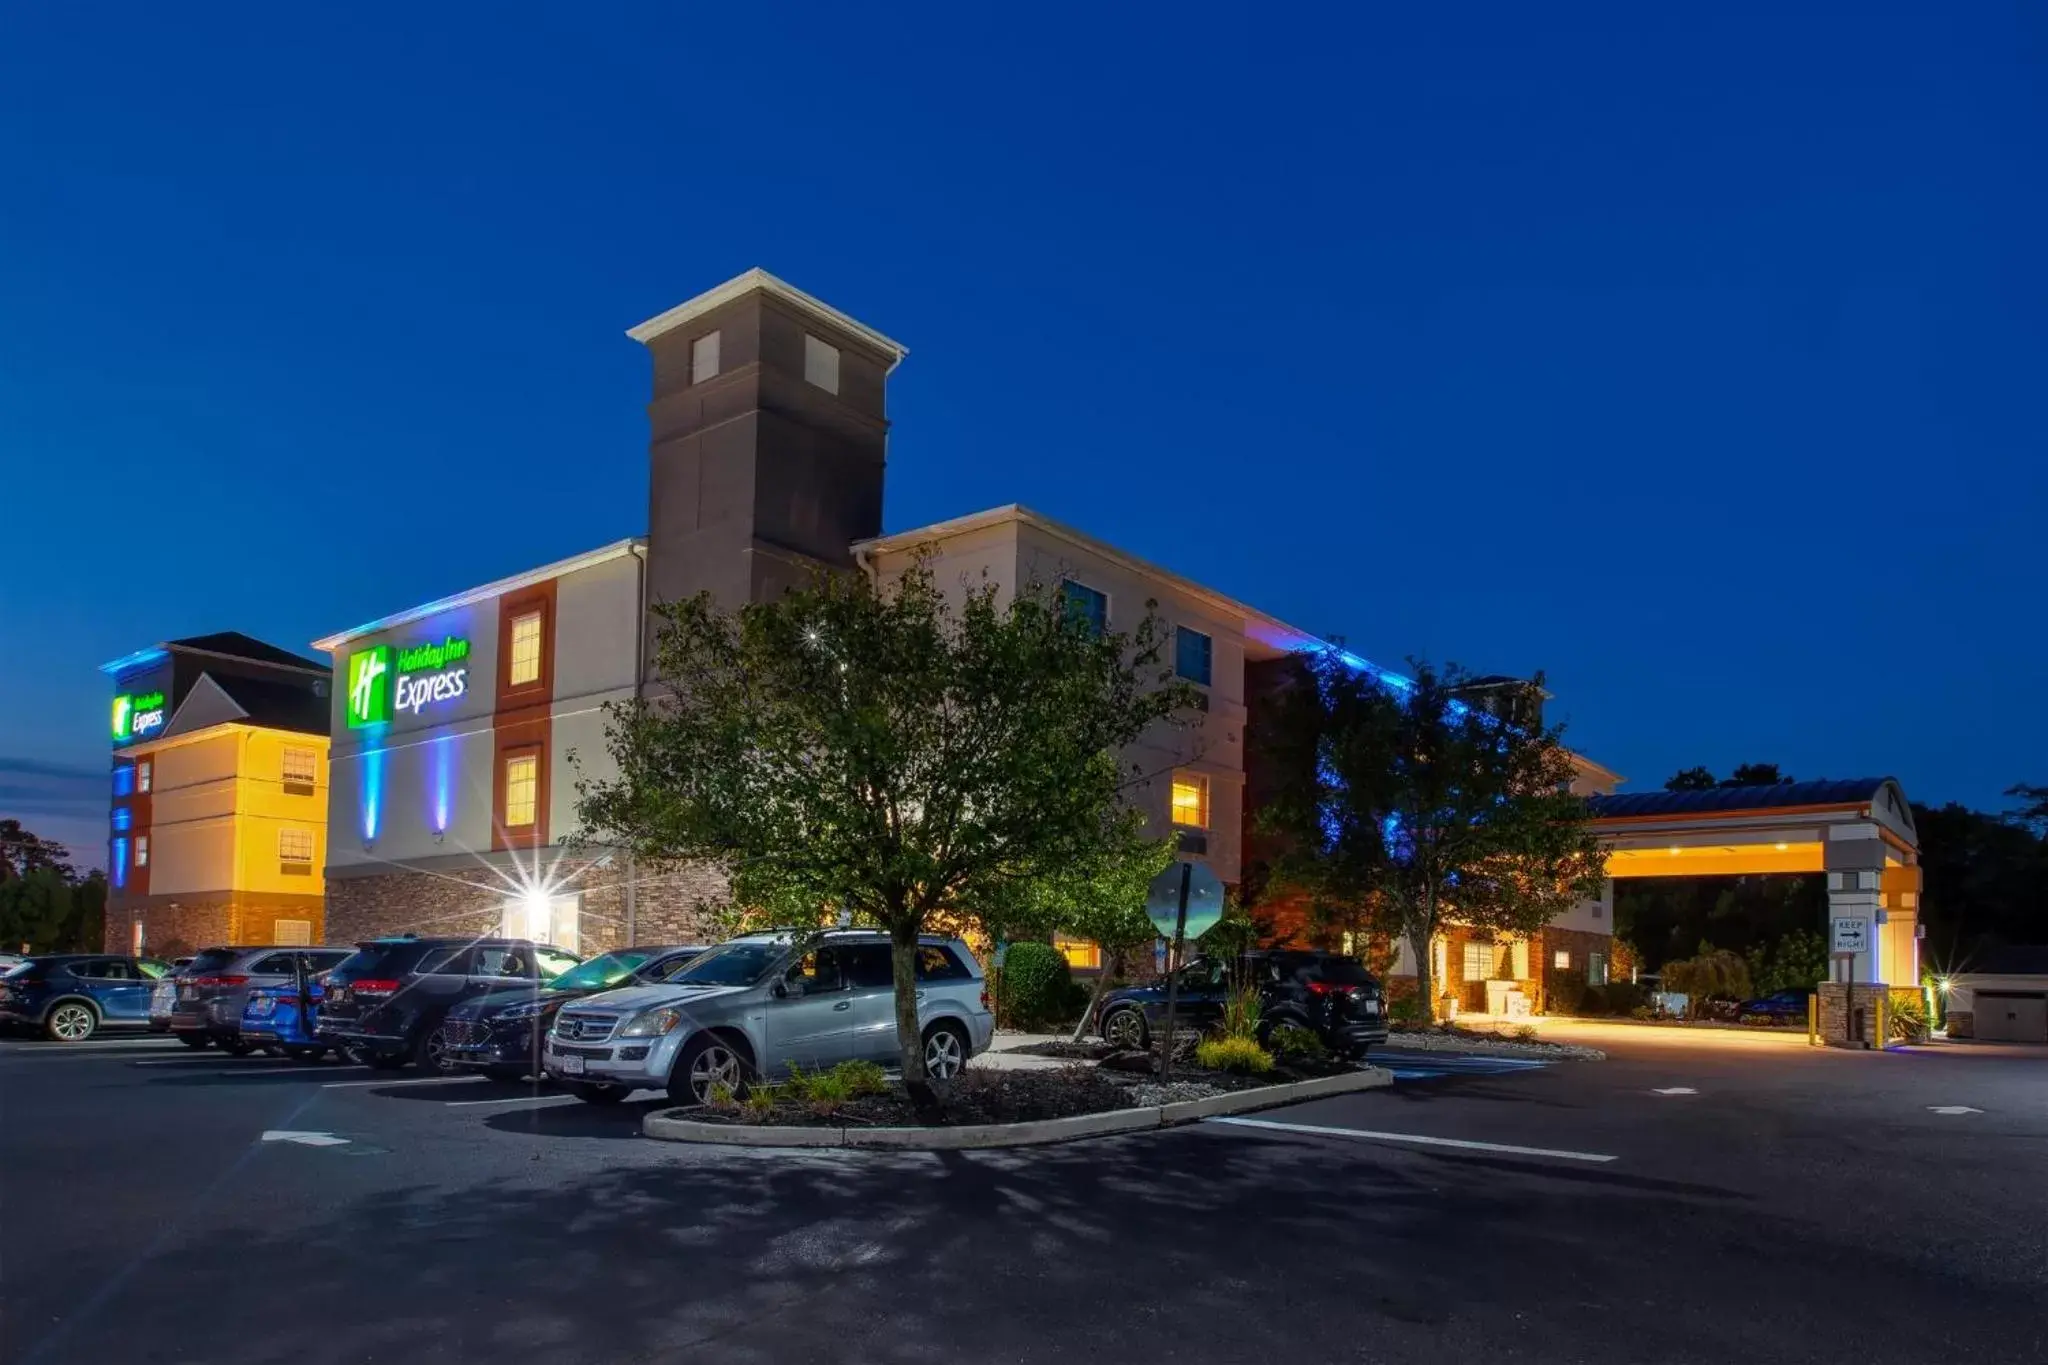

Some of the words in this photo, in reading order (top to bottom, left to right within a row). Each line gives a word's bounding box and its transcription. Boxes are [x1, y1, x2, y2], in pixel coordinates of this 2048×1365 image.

[398, 643, 445, 671] Holiday
[445, 636, 468, 660] Inn
[395, 669, 465, 714] Express
